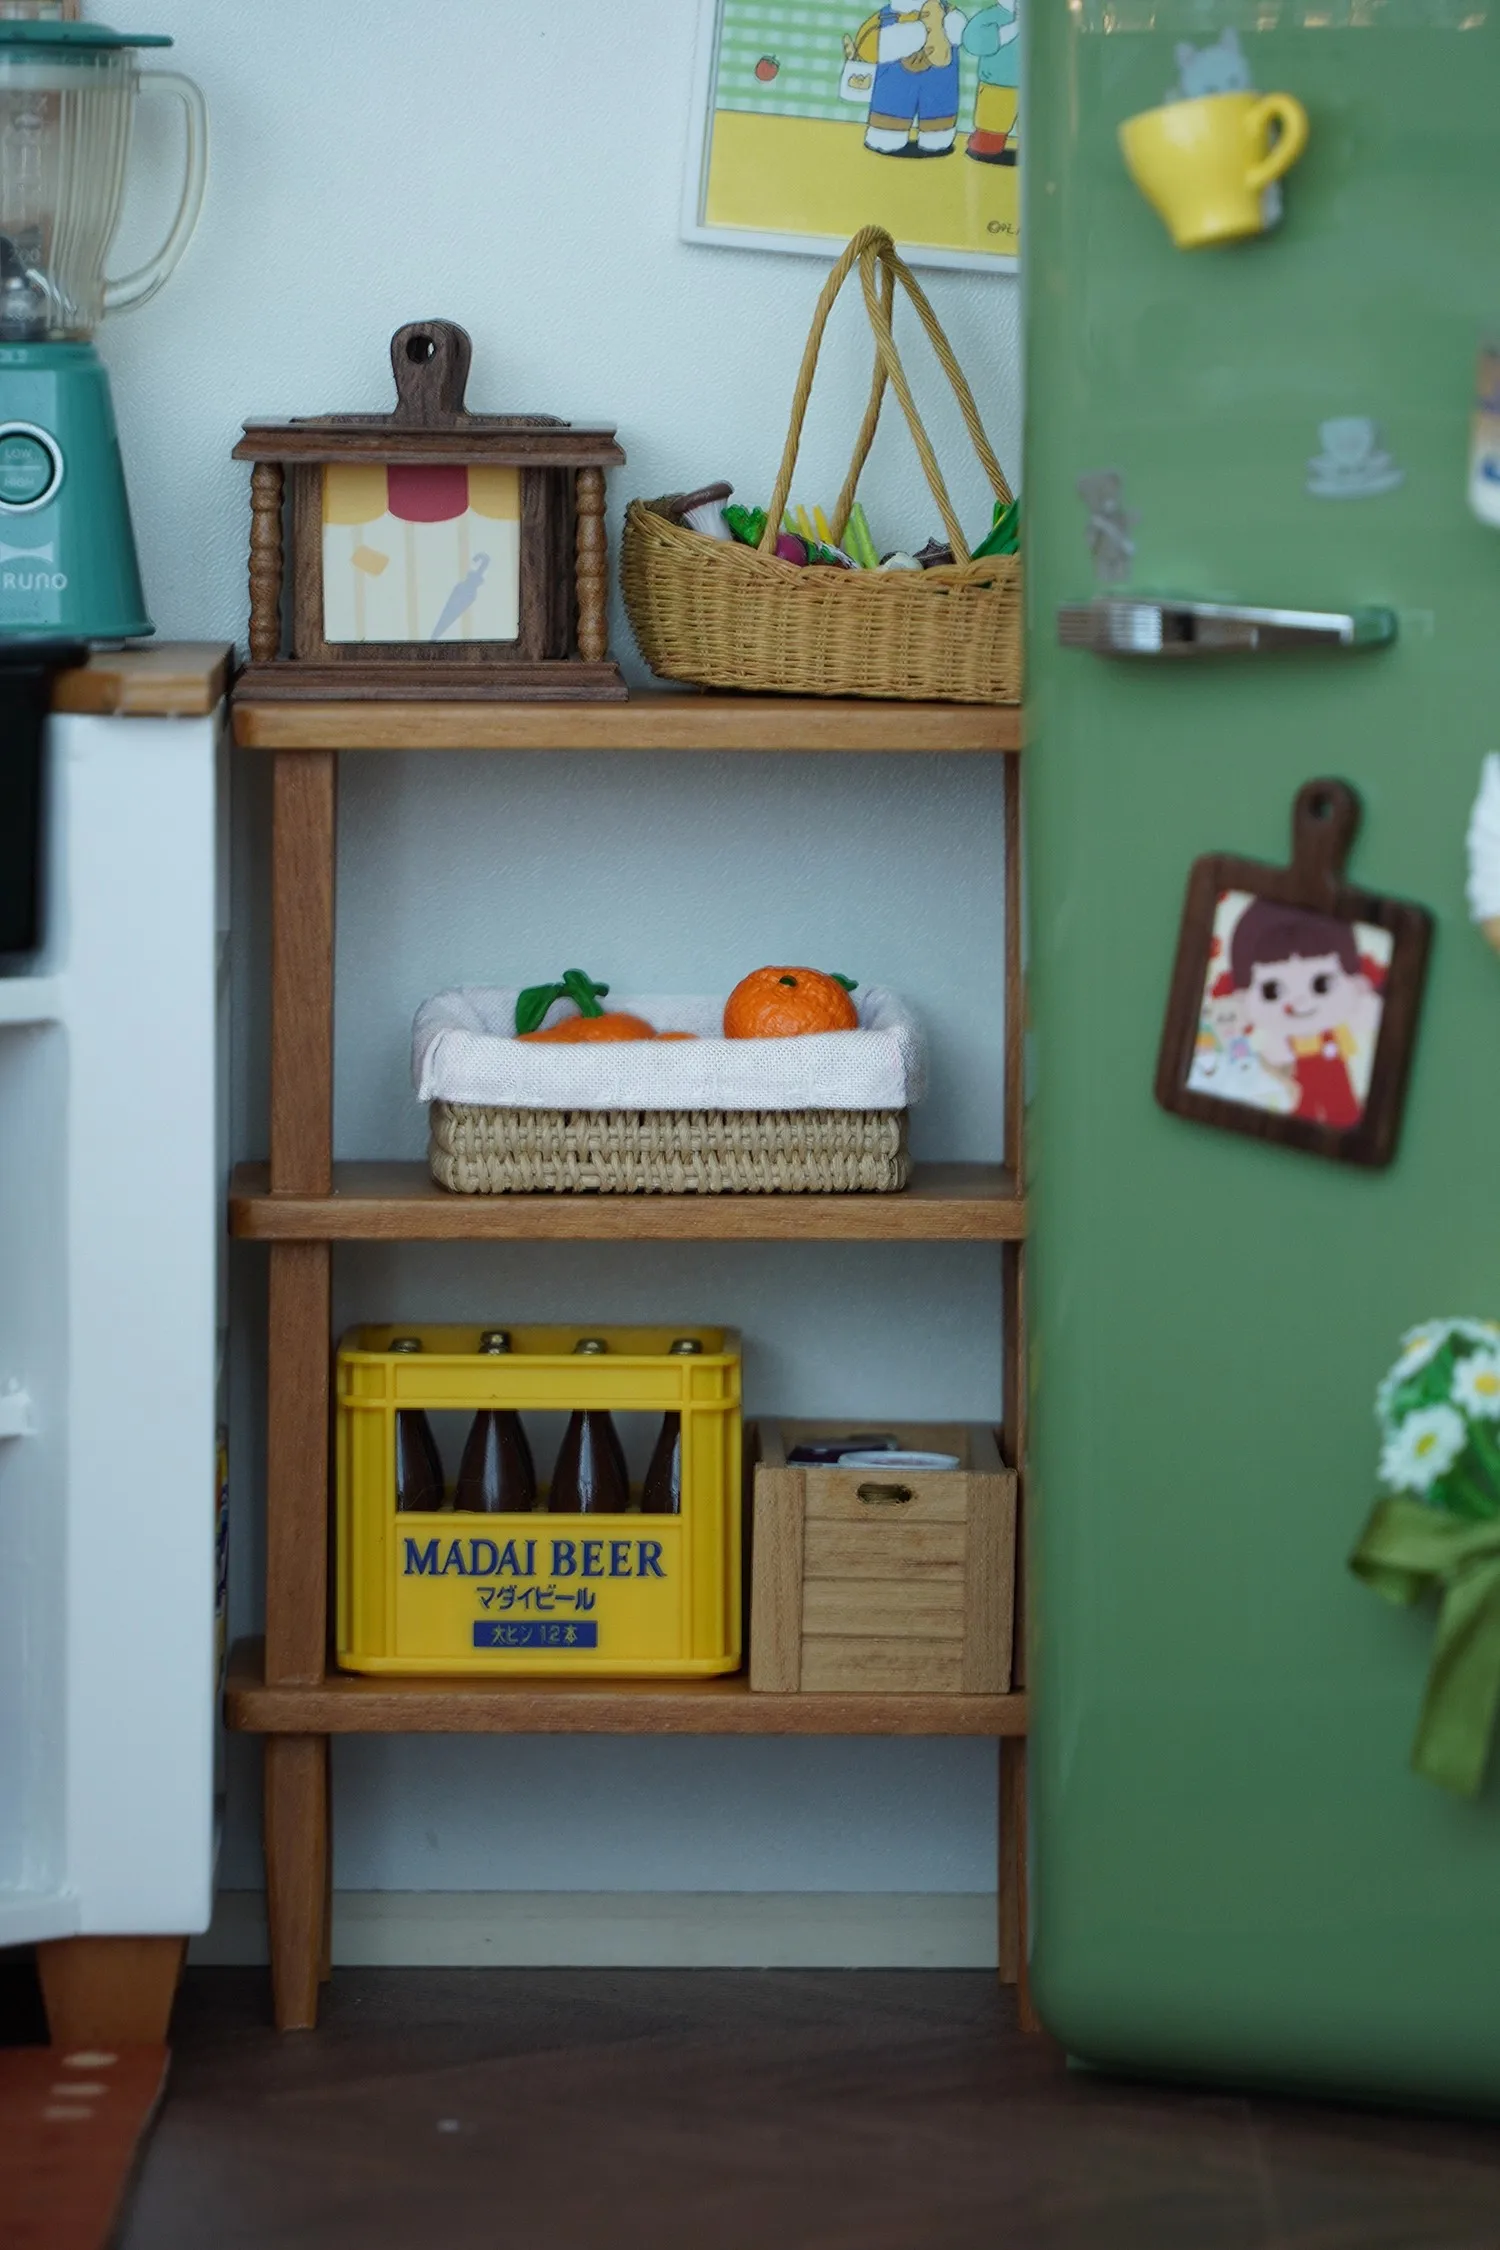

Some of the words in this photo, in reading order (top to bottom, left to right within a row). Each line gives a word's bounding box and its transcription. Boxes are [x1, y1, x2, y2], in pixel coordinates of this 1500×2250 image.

[403, 1538, 538, 1577] MADAI
[550, 1540, 668, 1578] BEER
[476, 1584, 597, 1612] マダイビール
